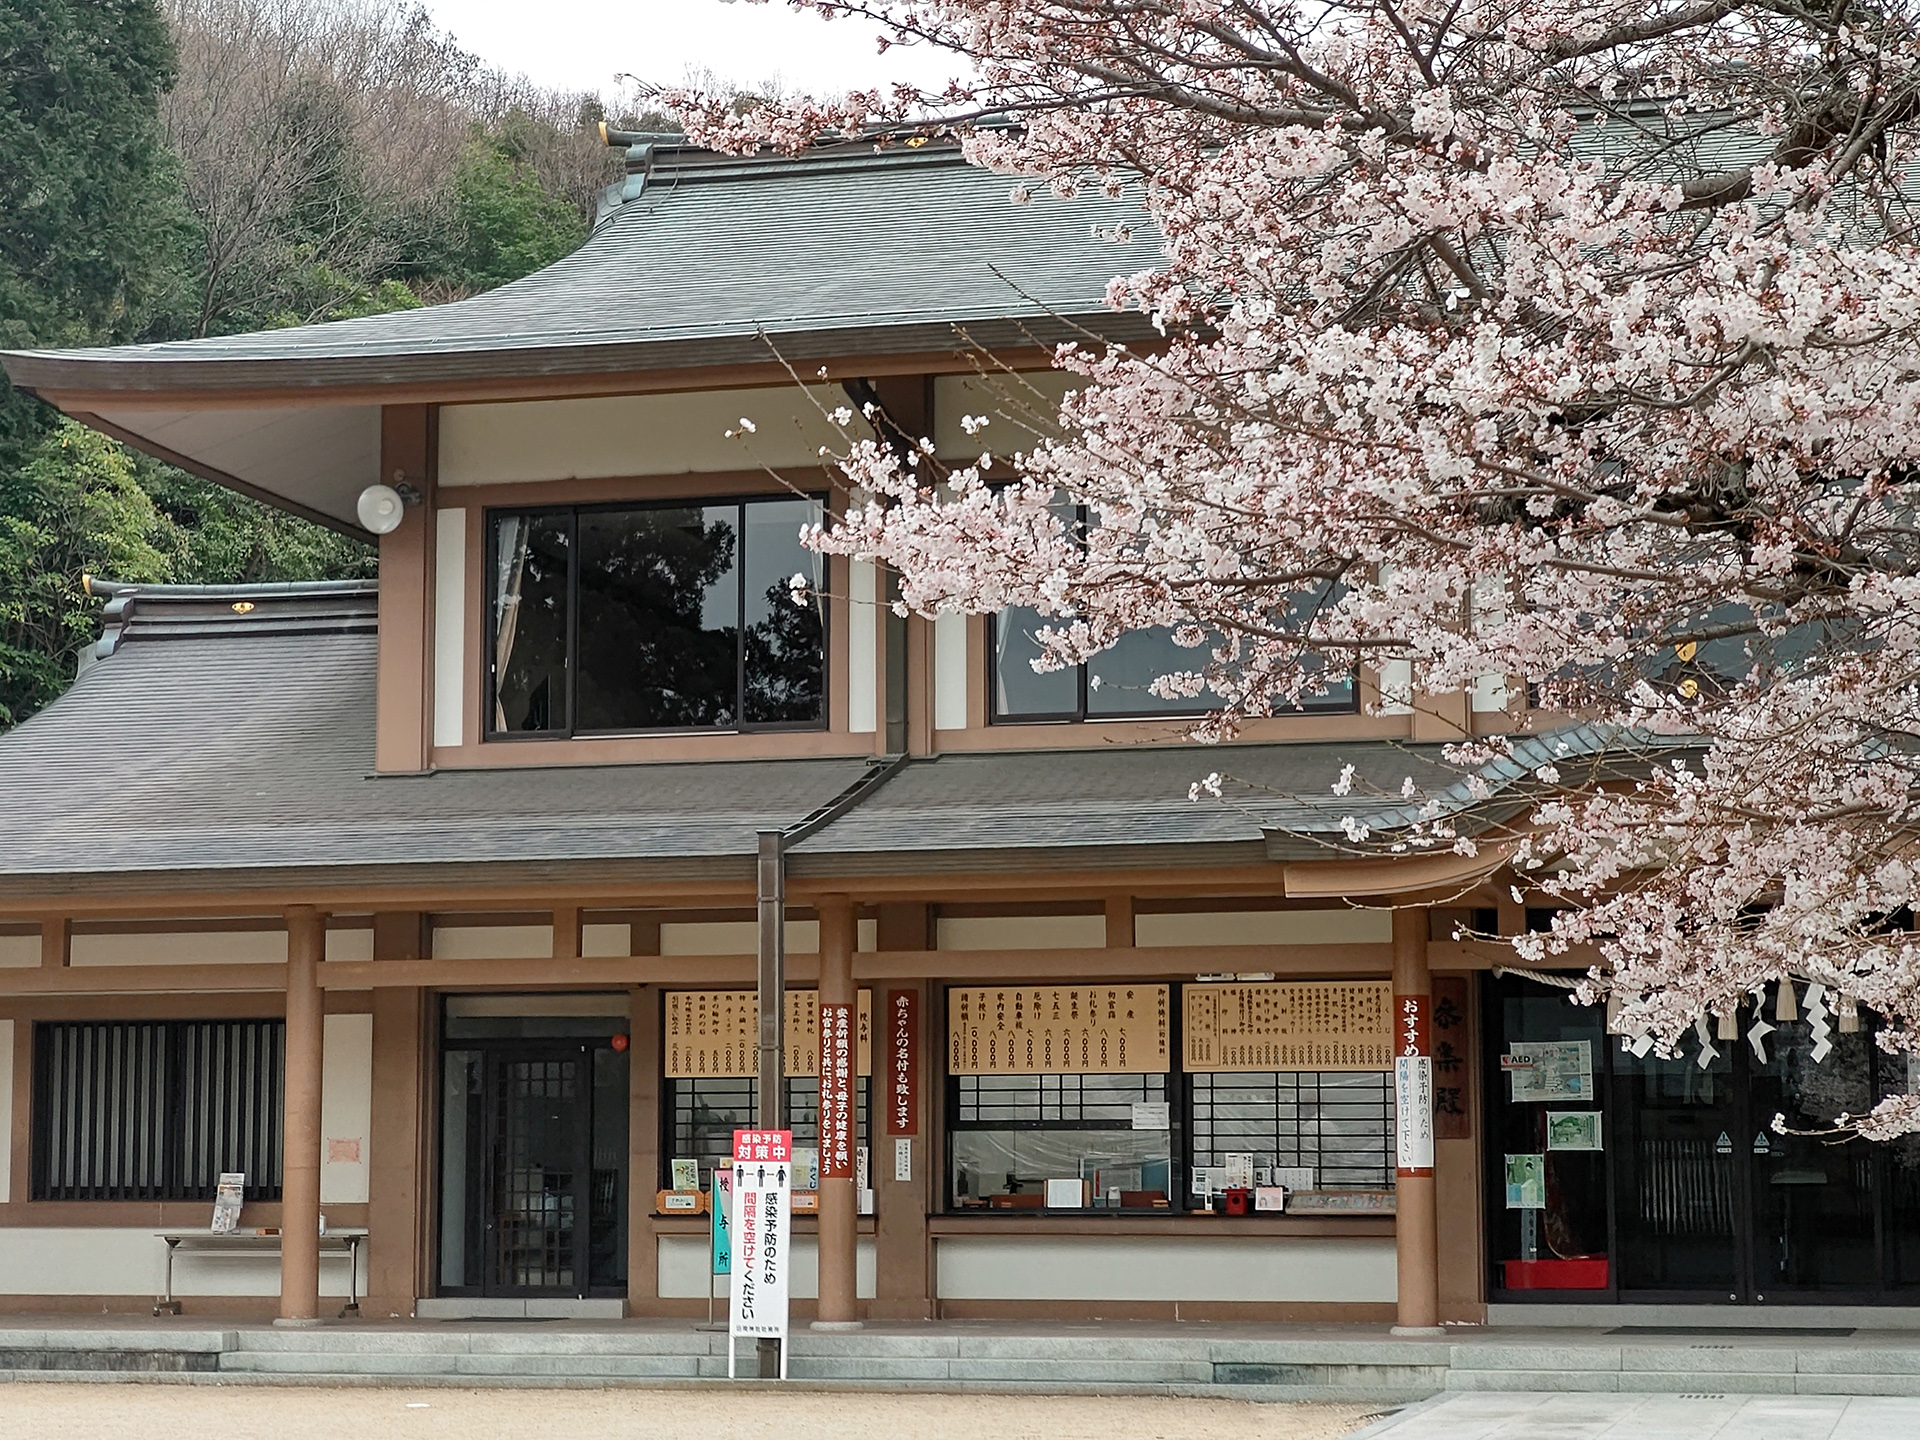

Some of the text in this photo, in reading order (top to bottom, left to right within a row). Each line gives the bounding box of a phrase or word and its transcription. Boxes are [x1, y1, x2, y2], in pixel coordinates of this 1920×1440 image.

[997, 993, 1005, 1030] 家内安全
[1127, 990, 1134, 1018] 安産
[1403, 1000, 1420, 1057] おすすめ
[896, 996, 910, 1128] 赤ちゃんの名付も致します
[1511, 1055, 1531, 1064] AED
[1418, 1058, 1429, 1140] 感染予防のため
[738, 1145, 786, 1160] 対策中
[742, 1134, 782, 1144] 感染予防
[719, 1177, 730, 1267] 授与所
[764, 1192, 778, 1284] 感染予防のため
[741, 1192, 756, 1320] 間隔を空けてください
